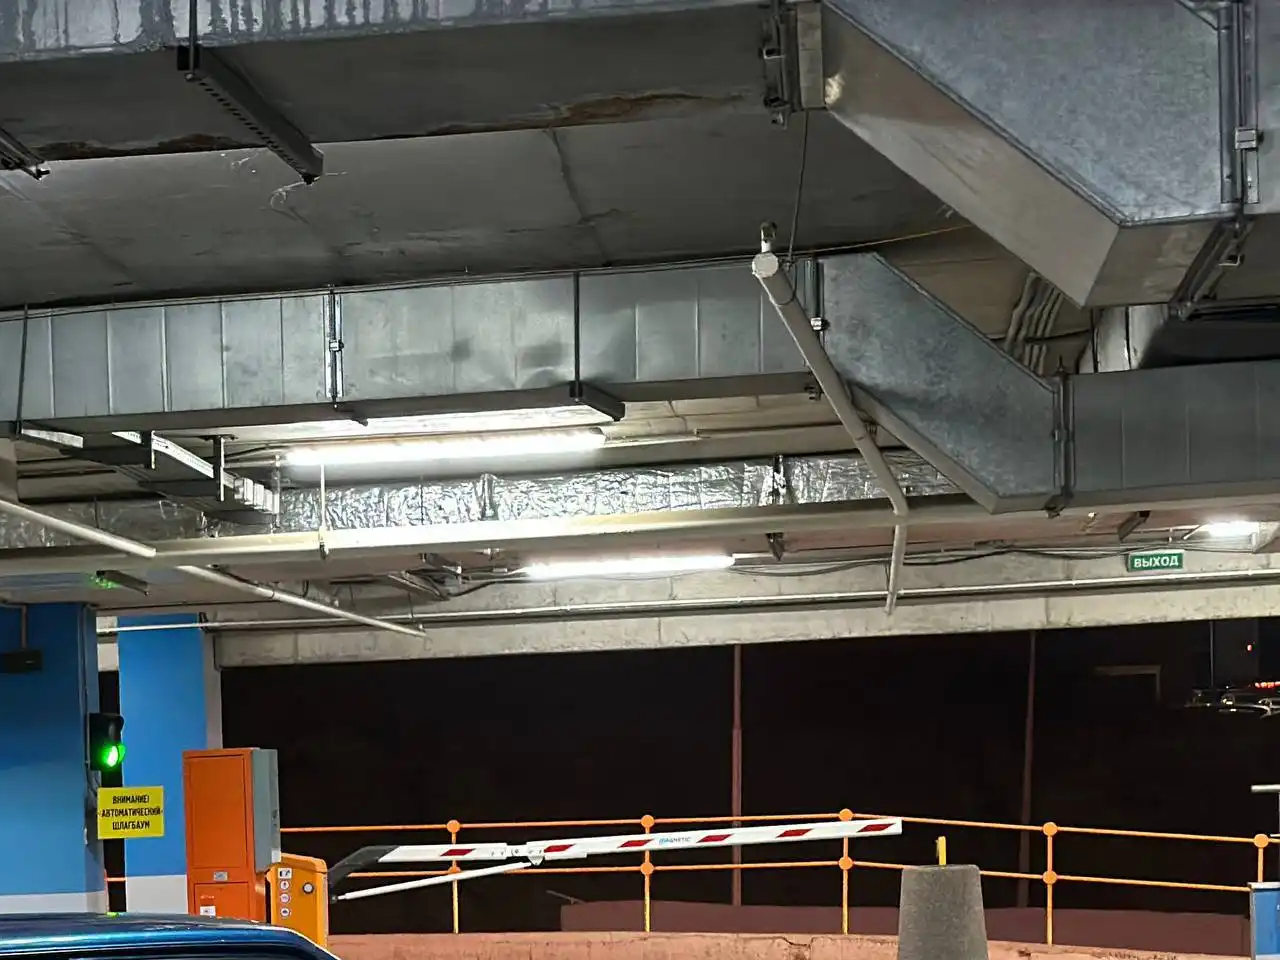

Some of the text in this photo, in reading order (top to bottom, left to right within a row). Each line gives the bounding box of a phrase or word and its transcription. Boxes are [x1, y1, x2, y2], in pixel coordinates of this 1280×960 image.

[1133, 555, 1179, 568] ВЫХОД
[101, 806, 161, 817] АВТОМАТИЧЕСКИЙ
[112, 820, 150, 830] ШЛАГБАУМ
